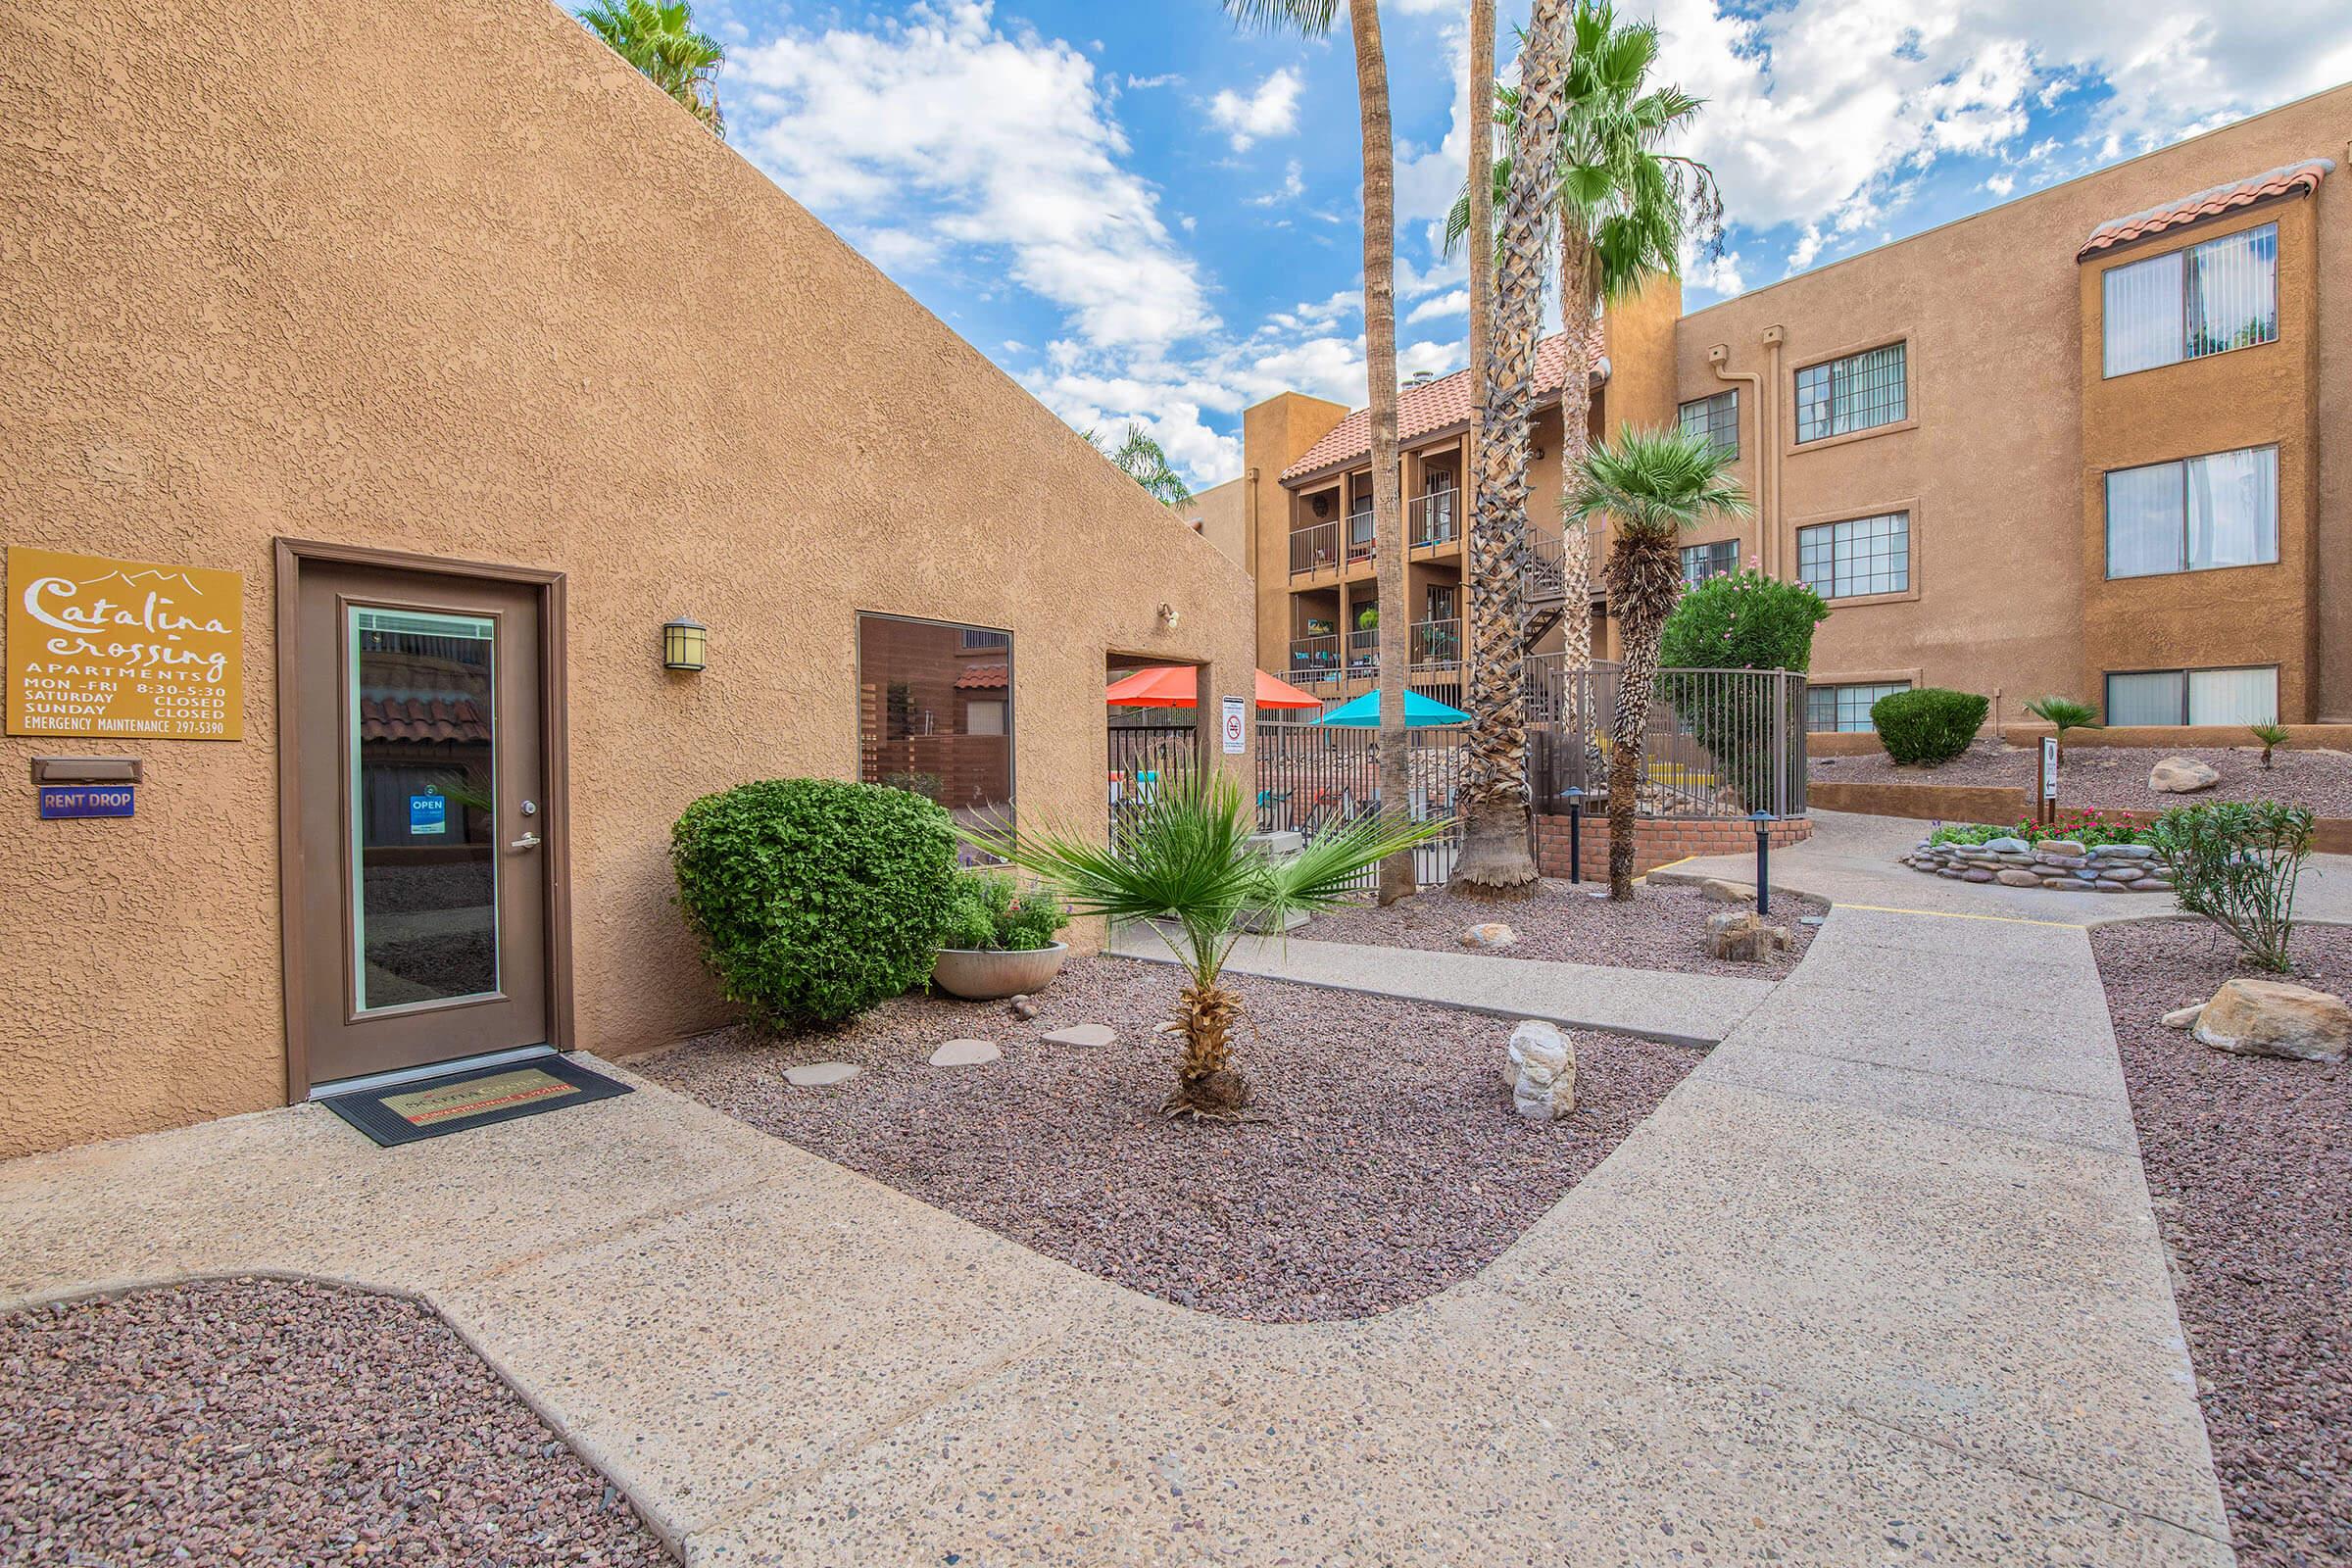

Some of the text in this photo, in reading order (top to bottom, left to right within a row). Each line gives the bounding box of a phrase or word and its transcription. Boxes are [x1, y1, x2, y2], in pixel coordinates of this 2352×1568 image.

[24, 576, 233, 634] Catalina
[25, 662, 202, 682] APARTMENTS
[24, 677, 71, 690] MON
[136, 683, 225, 697] 8:30-5:30
[24, 690, 225, 708] SATURDAY CLOSED
[24, 703, 225, 719] SUNDAY CLOSED
[24, 715, 224, 734] EMERGENCY MAINTENANCE 297-5390
[44, 793, 131, 808] RENT DROP
[413, 801, 442, 809] OPEN
